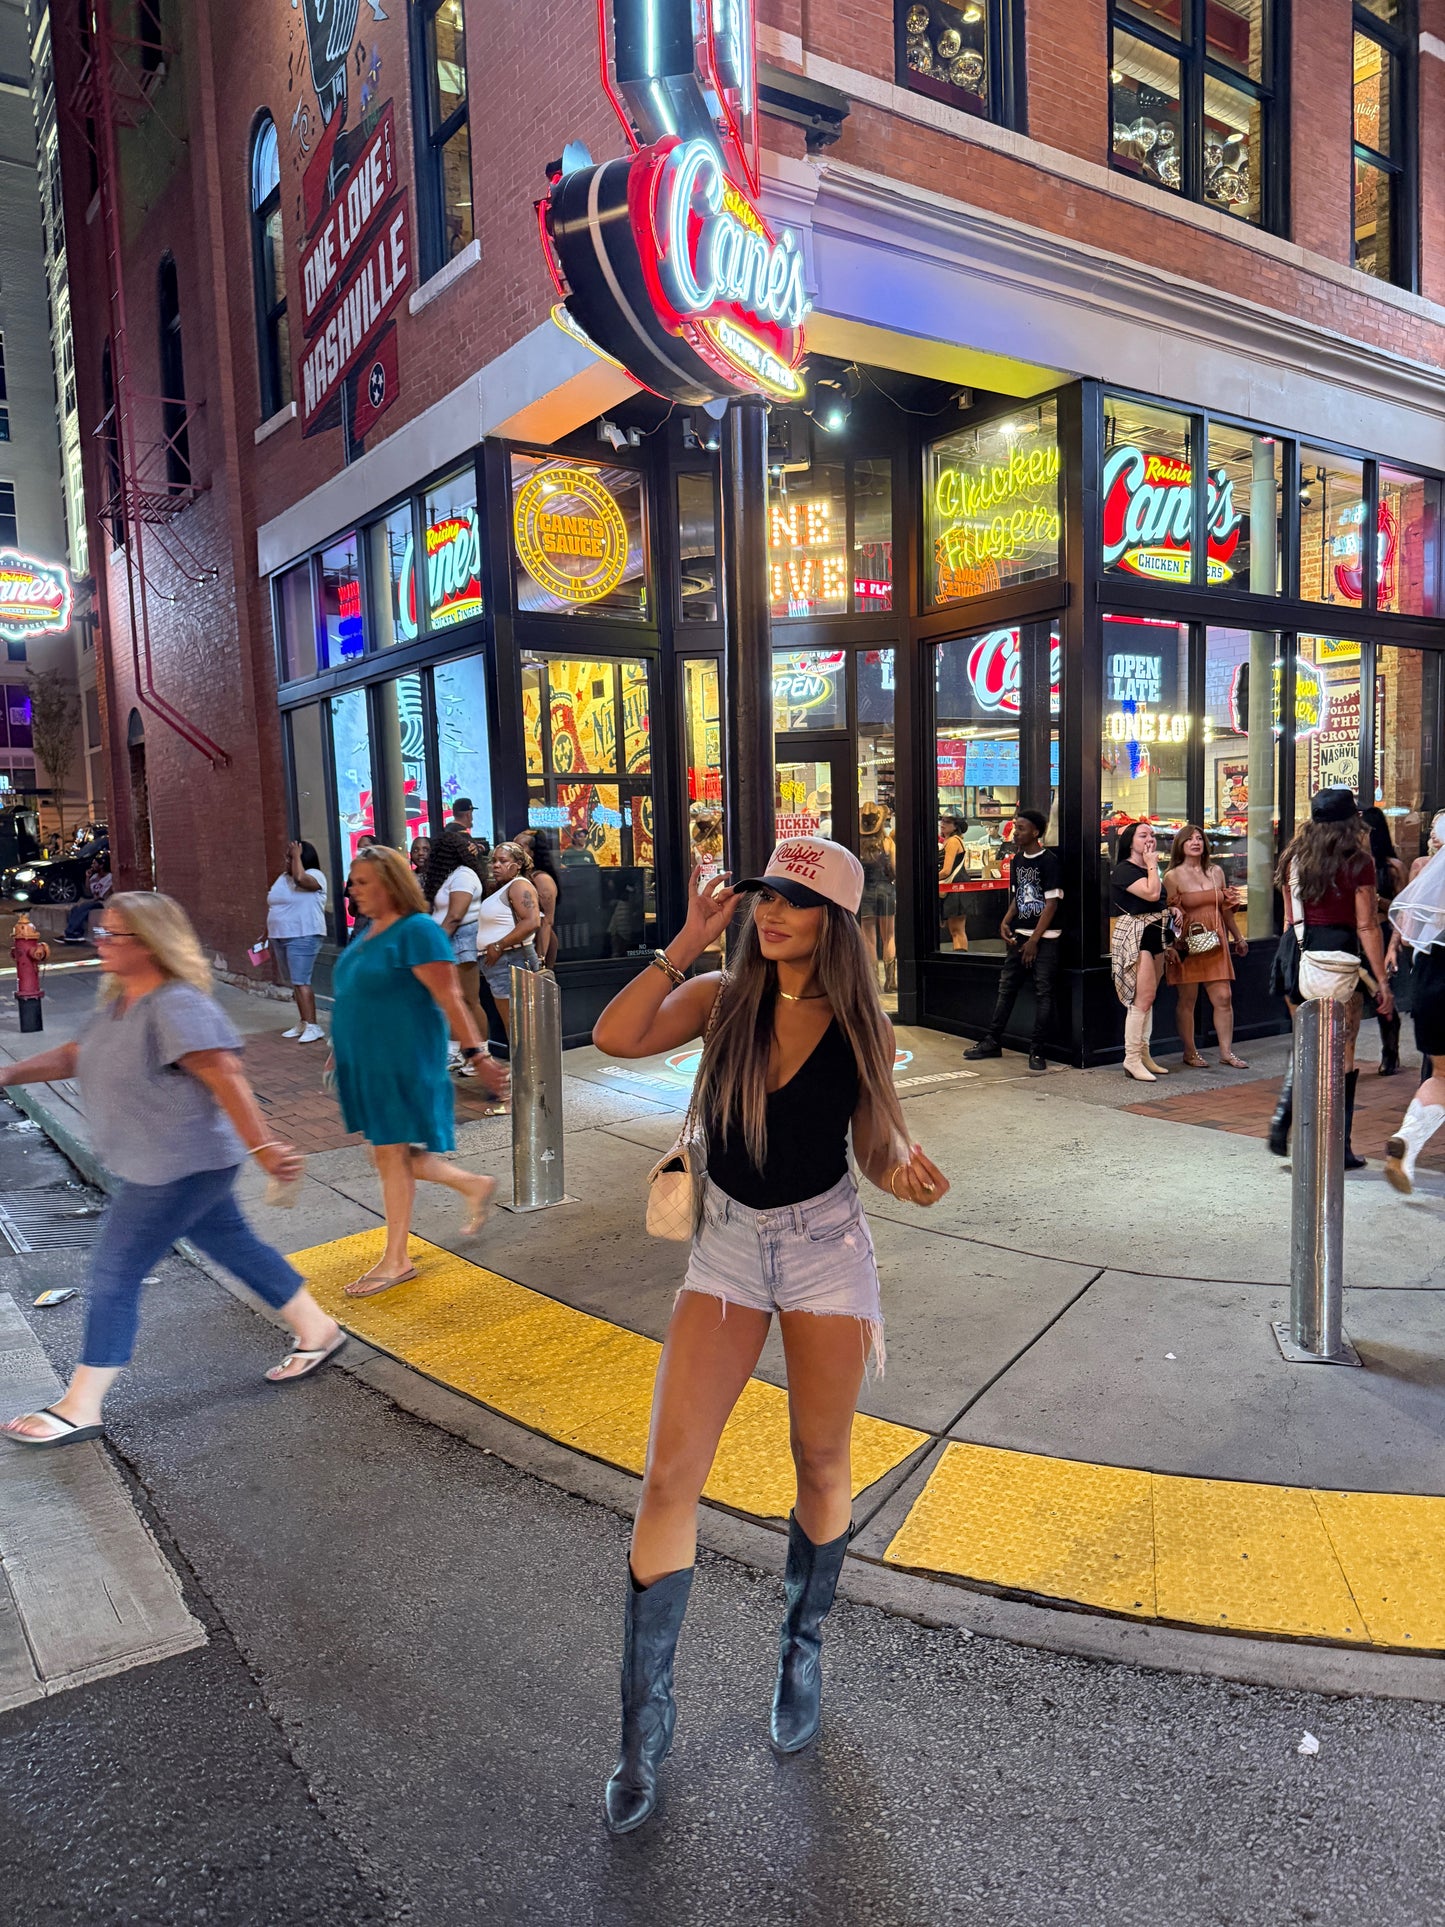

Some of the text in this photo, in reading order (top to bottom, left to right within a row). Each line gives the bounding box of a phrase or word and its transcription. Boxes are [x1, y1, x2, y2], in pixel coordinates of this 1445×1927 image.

[384, 119, 392, 182] FOR
[304, 135, 385, 317] ONE LOVE
[670, 138, 813, 327] Cane's
[303, 210, 407, 419] NASHVILLE
[936, 446, 1059, 518] Chicken
[1145, 457, 1192, 484] Raisin
[426, 521, 460, 551] Raising
[539, 513, 605, 538] CANE'S
[768, 503, 829, 547] NE
[543, 532, 603, 557] SAUCE
[941, 504, 1060, 573] Fingers
[1138, 553, 1224, 578] CHICKEN FERS
[0, 573, 62, 602] ane's
[1112, 654, 1160, 680] OPEN
[772, 676, 821, 697] PEN
[1113, 677, 1160, 702] LATE
[551, 708, 564, 736] NE
[1110, 713, 1156, 742] ONE
[1331, 716, 1360, 728] THE
[1319, 729, 1360, 742] CROW
[1320, 747, 1358, 767] NASHVIL
[1320, 771, 1358, 788] TENNESS
[776, 830, 814, 839] INGERS
[769, 842, 825, 869] Raisin'
[785, 862, 817, 880] HELL
[626, 949, 656, 957] TRESPASSIN
